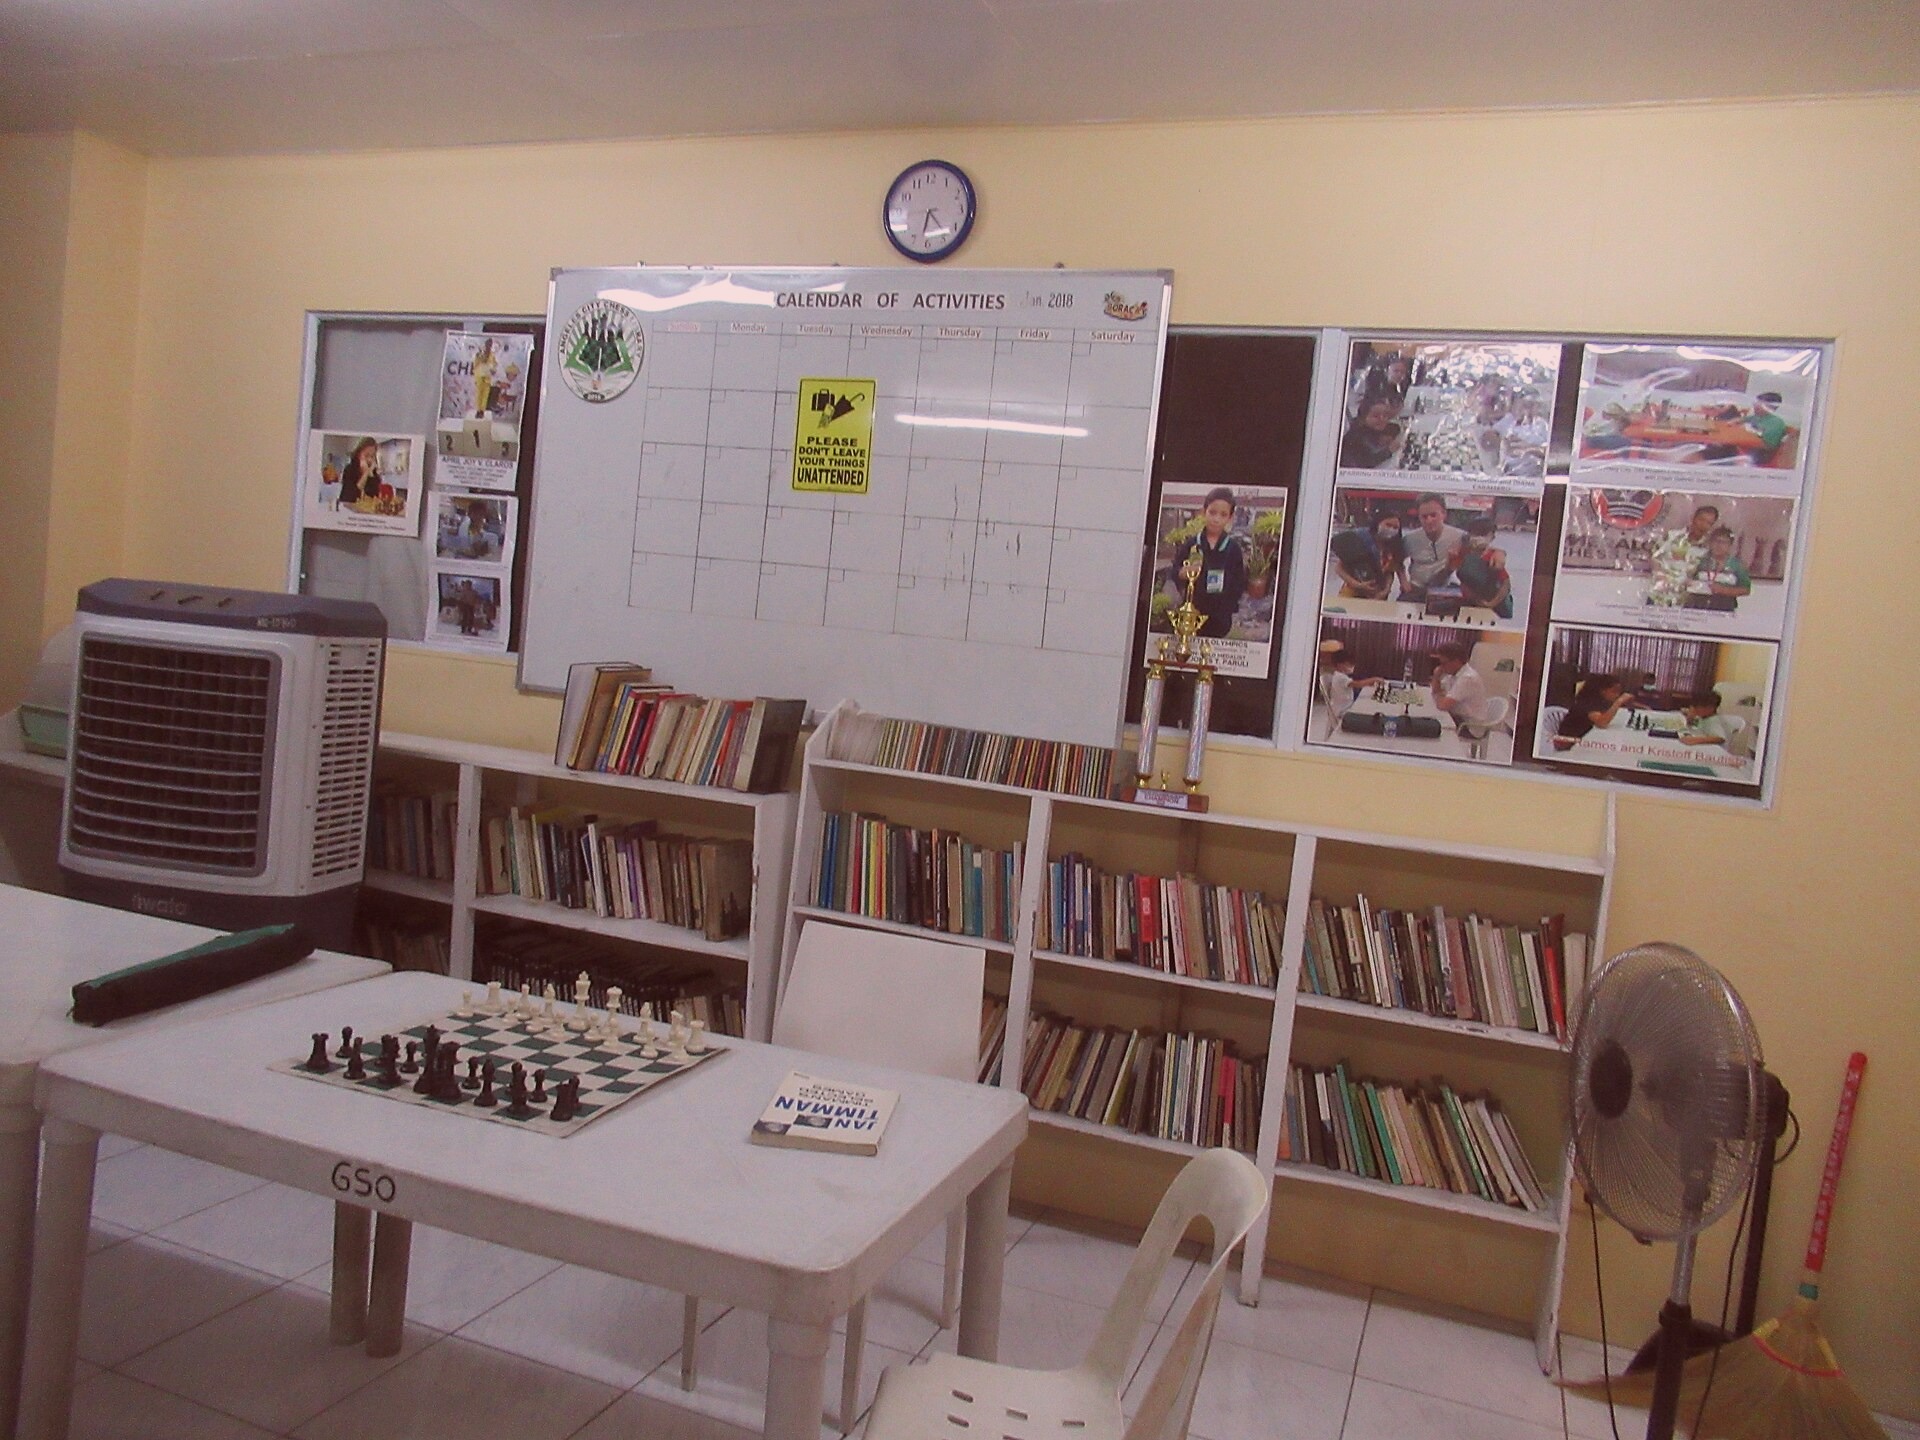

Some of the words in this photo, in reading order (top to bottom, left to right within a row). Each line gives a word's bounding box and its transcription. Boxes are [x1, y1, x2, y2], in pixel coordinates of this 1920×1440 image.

[776, 292, 862, 308] CALENDAR
[877, 292, 900, 308] OF
[912, 293, 1005, 310] ACTIVITIES
[1047, 292, 1074, 308] 2018
[731, 322, 766, 333] Monday
[799, 324, 834, 335] Tuesday
[860, 325, 913, 336] Wednesday
[939, 327, 982, 339] Thursday
[1019, 329, 1050, 339] Friday
[1091, 331, 1136, 342] Saturday
[807, 436, 858, 447] PLEASE
[799, 446, 830, 456] DON'T
[833, 448, 866, 458] LEAVE
[799, 457, 825, 466] YOUR
[828, 458, 865, 468] THINGS
[797, 467, 864, 486] UNATTENDED
[1211, 640, 1248, 648] OLYMPICS
[1620, 743, 1644, 754] and
[1647, 745, 1691, 759] Kristoff
[774, 1095, 879, 1120] TIMMAN
[331, 1161, 396, 1203] GSO
